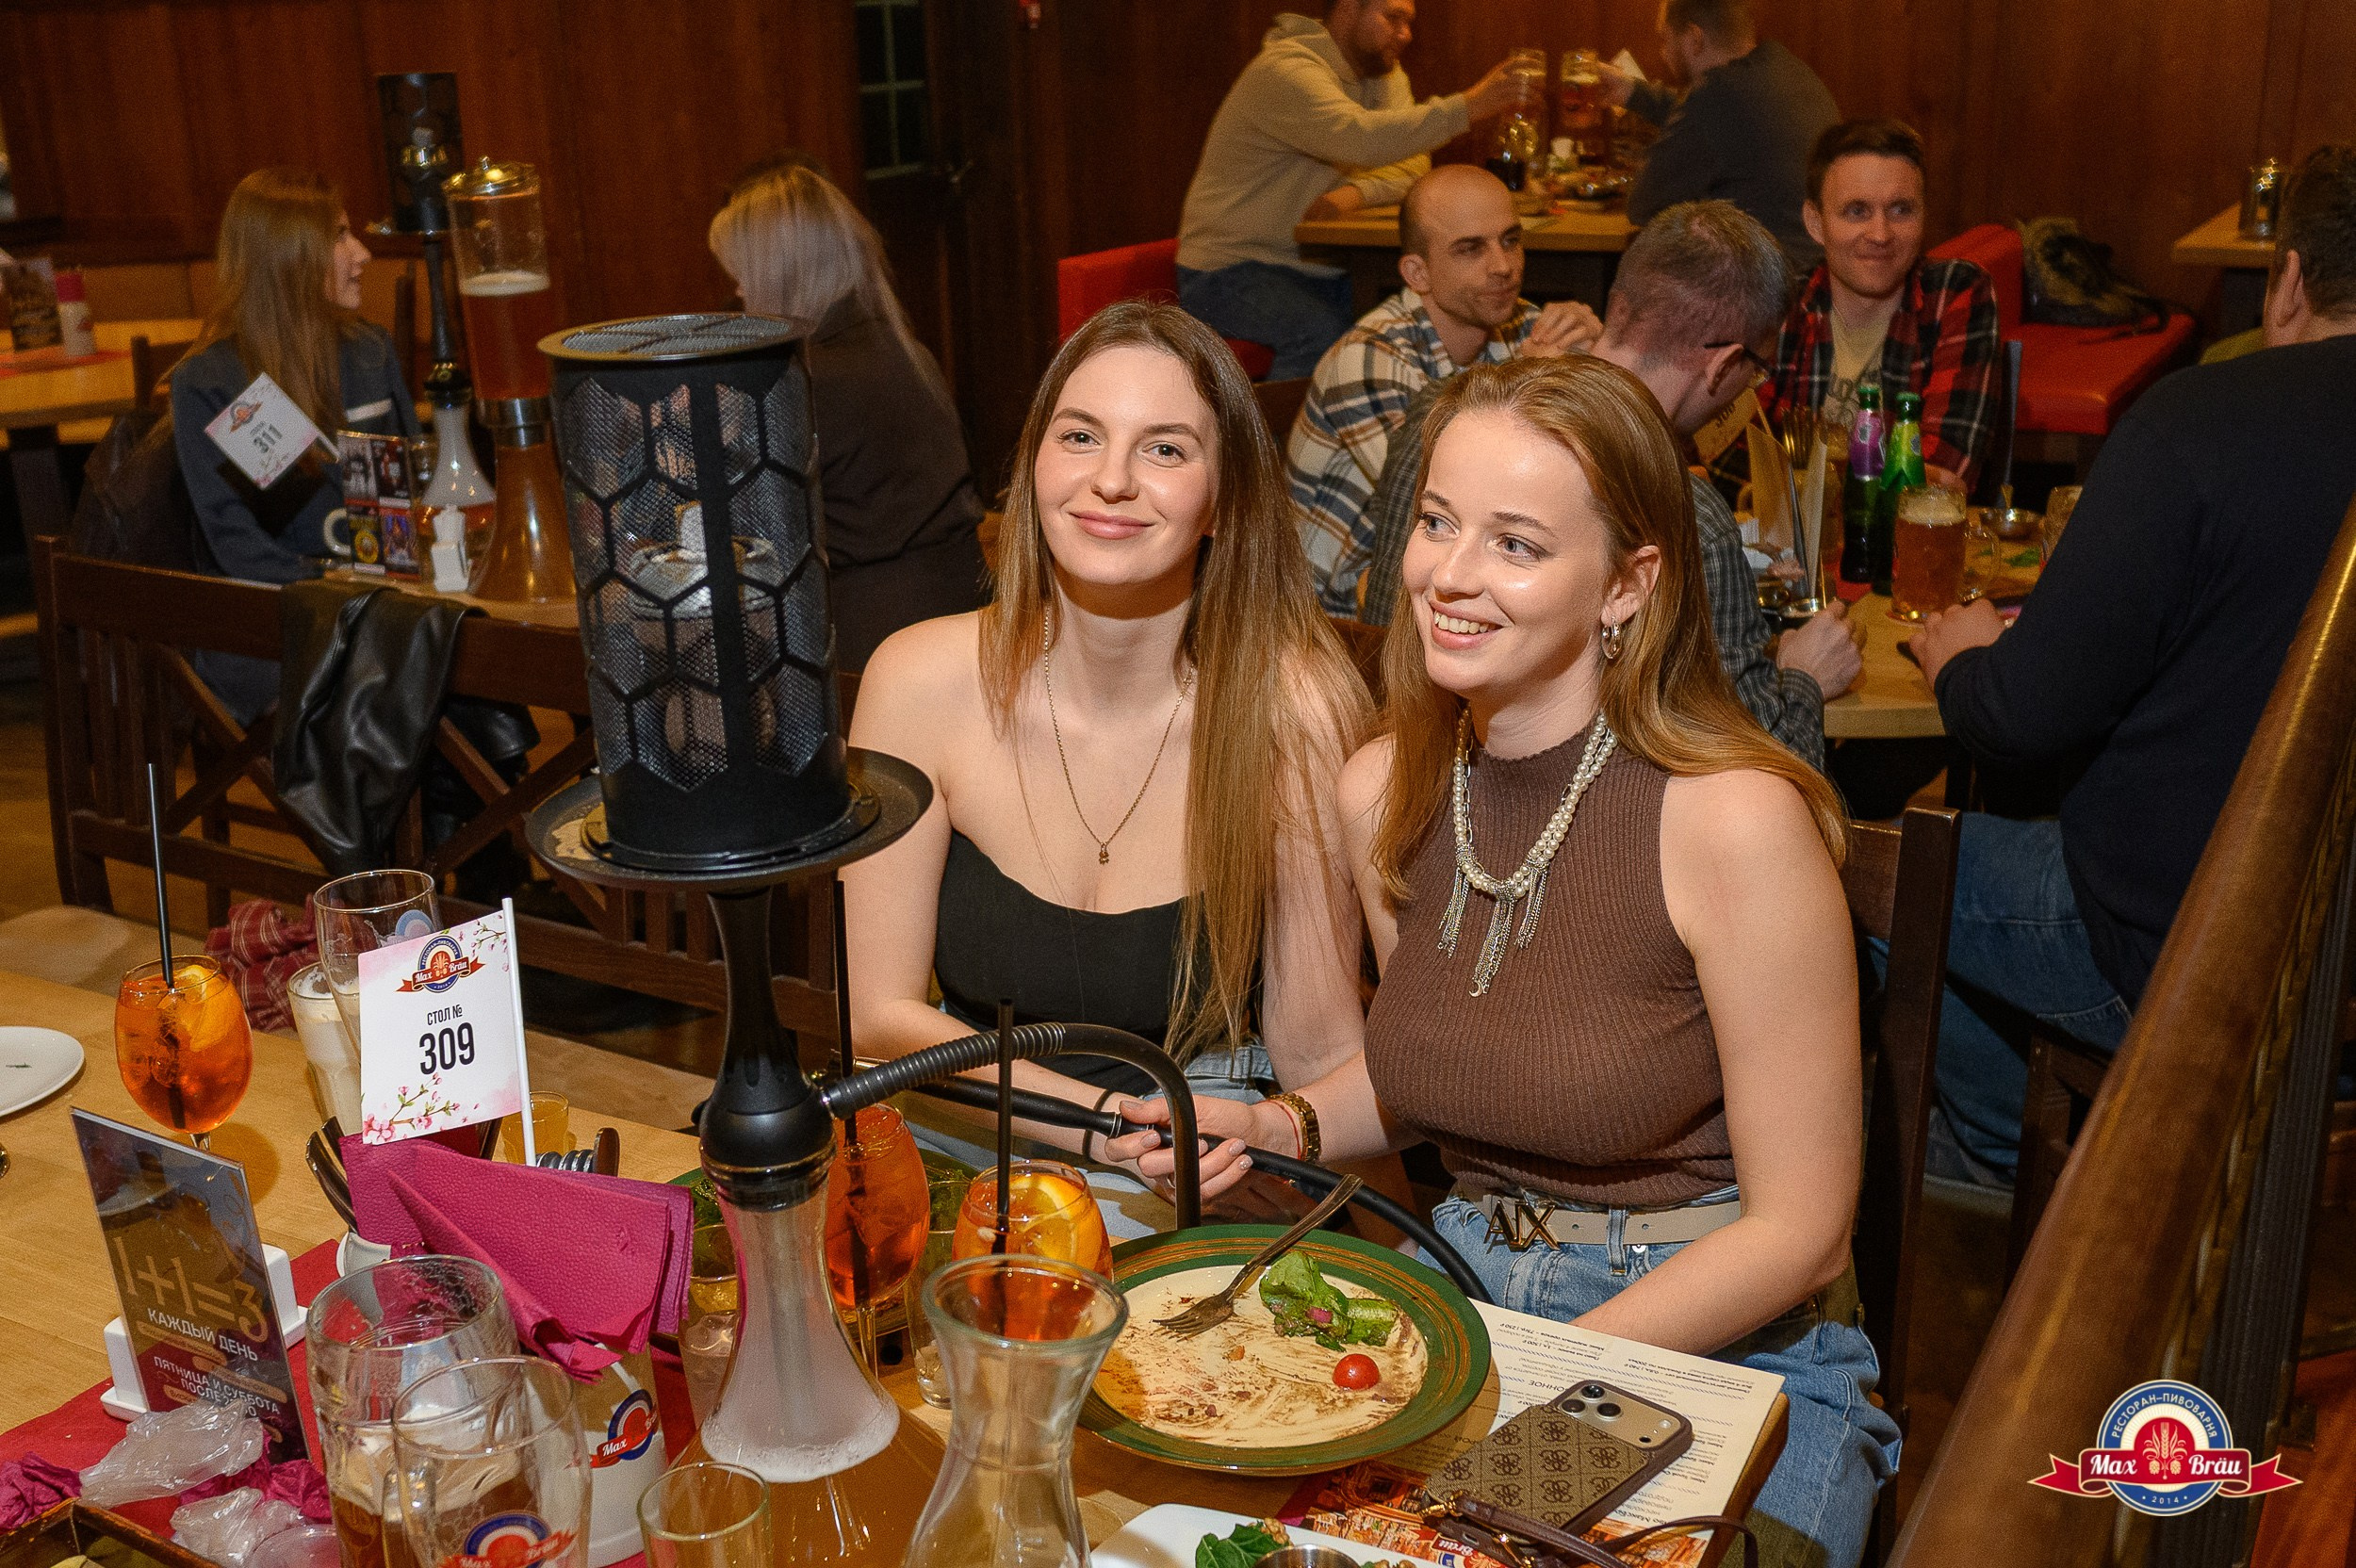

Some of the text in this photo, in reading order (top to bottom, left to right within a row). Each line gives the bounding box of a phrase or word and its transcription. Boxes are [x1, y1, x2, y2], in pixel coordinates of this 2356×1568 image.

[252, 423, 282, 453] 311
[416, 961, 467, 983] Max Bräu
[427, 1004, 463, 1025] СТОЛ №
[419, 1022, 475, 1075] 309
[113, 1236, 269, 1344] 1+1=3
[147, 1307, 216, 1346] КАЖДЫЙ
[219, 1334, 258, 1362] ДЕНЬ
[154, 1356, 209, 1388] ПЯТНИЦА
[212, 1379, 222, 1391] И
[223, 1385, 280, 1415] СУББОТА
[180, 1378, 222, 1403] ПОСЛЕ
[602, 1439, 628, 1457] Max
[1438, 1538, 1473, 1556] Bräu
